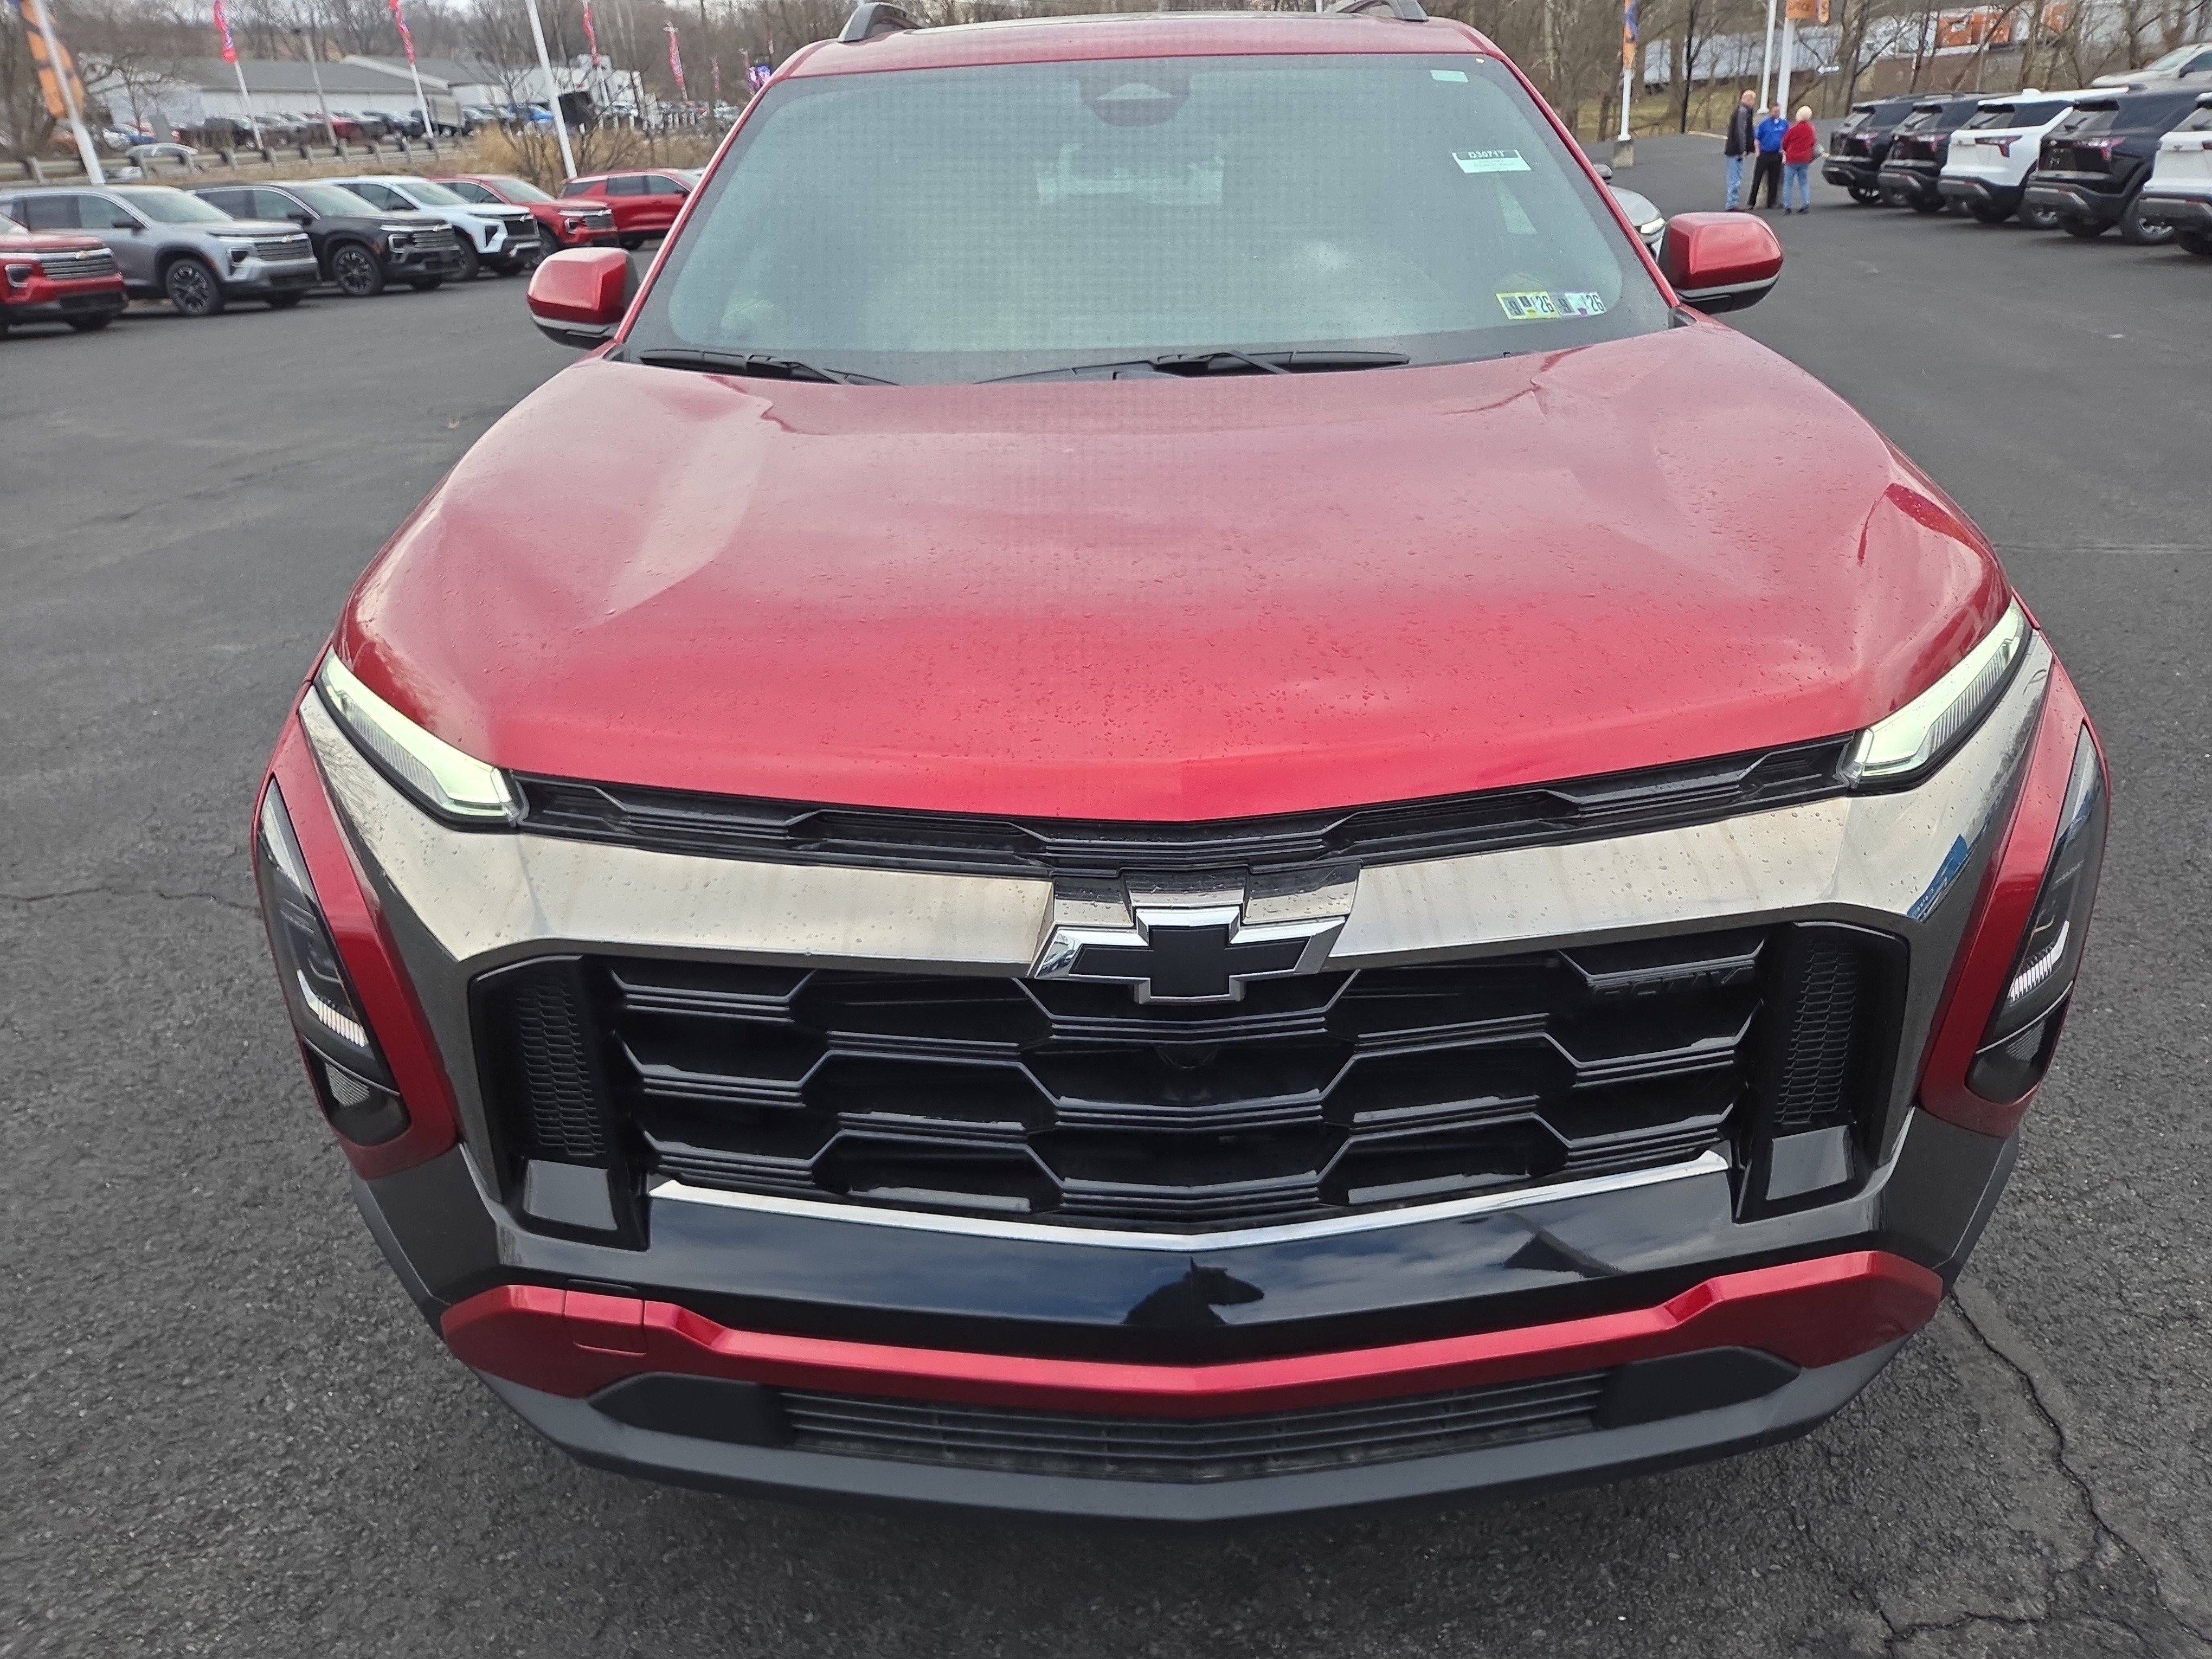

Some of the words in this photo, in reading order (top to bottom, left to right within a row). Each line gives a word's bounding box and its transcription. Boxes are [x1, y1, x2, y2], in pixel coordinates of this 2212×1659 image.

[1468, 150, 1504, 159] D3071T
[1509, 300, 1522, 316] 9
[1558, 298, 1572, 314] 9
